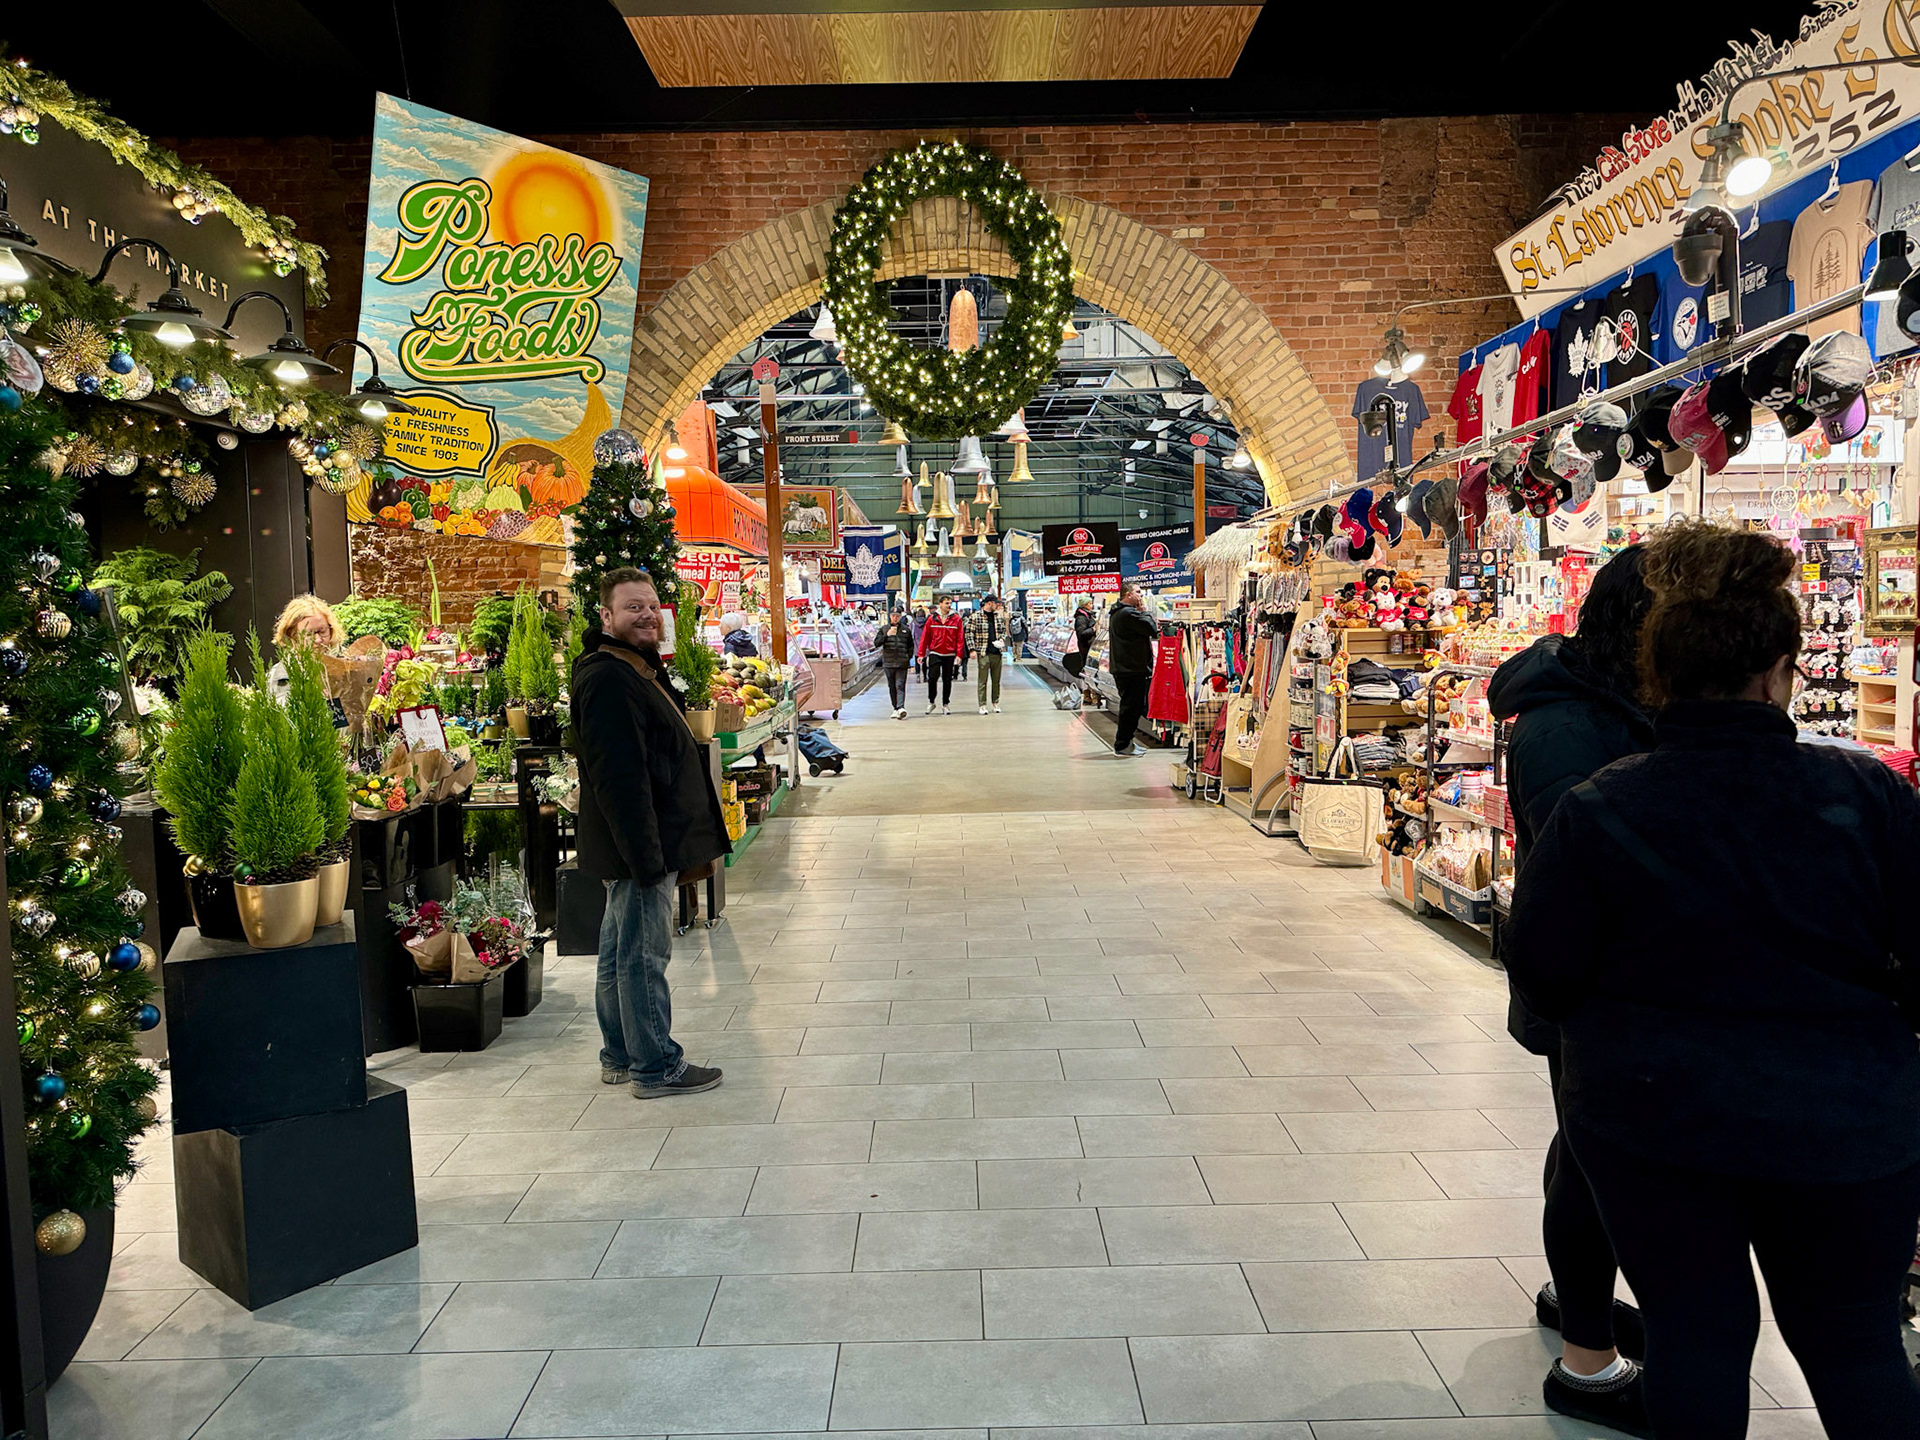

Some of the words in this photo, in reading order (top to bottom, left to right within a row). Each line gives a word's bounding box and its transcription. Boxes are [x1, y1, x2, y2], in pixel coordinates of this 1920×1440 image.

[1799, 7, 1837, 42] Since
[1677, 80, 1715, 122] the
[1668, 110, 1688, 134] in
[1623, 124, 1672, 165] Store
[376, 177, 623, 298] Ponesse
[1510, 240, 1556, 299] St.
[1547, 157, 1691, 273] Lawrence
[42, 198, 70, 229] AT
[88, 218, 131, 258] THE
[146, 246, 229, 301] MRKET
[398, 286, 606, 384] Foods
[1760, 386, 1794, 411] SS
[393, 417, 401, 426] &
[407, 419, 469, 437] FRESHNESS
[387, 428, 425, 442] FAMILY
[431, 435, 484, 452] TRADITION
[396, 443, 427, 456] SINCE
[433, 449, 459, 461] 1903
[1631, 452, 1655, 468] ADA
[1126, 532, 1147, 540] CERTIFIED
[676, 550, 739, 564] PECIAL
[822, 557, 844, 569] DEL
[677, 566, 706, 580] ameal
[710, 567, 740, 580] Bacon
[822, 573, 845, 583] COUNTE
[1060, 564, 1105, 572] 416-777-0181
[724, 583, 740, 592] ONLY
[1090, 583, 1118, 591] ORDERS
